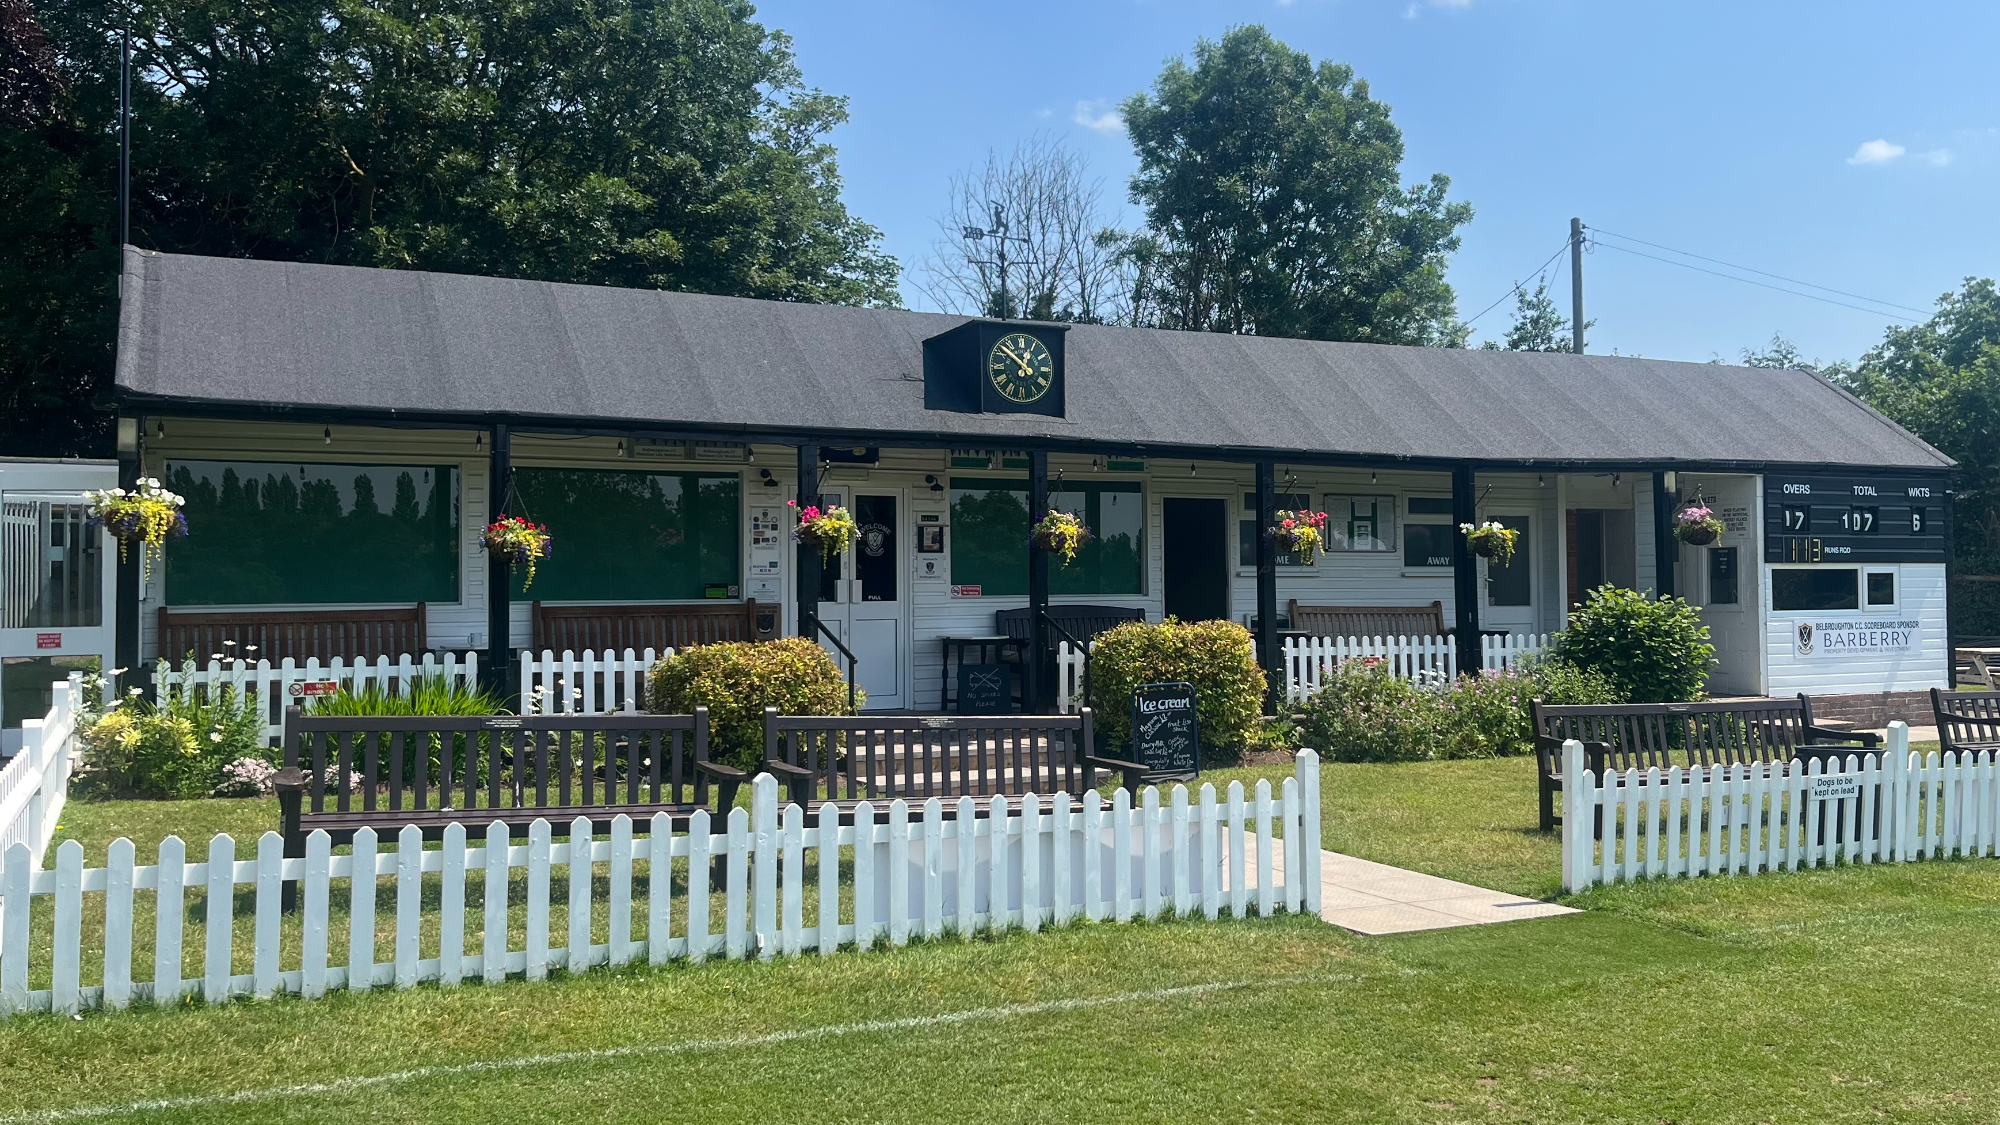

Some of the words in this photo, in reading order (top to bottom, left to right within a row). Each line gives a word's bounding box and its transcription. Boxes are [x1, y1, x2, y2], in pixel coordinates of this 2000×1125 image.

[1784, 484, 1810, 494] OVERS
[1853, 486, 1877, 496] TOTAL
[1908, 488, 1930, 497] WKTS
[1785, 511, 1804, 530] 17
[1842, 514, 1873, 531] 107
[1913, 514, 1920, 531] 6
[860, 523, 892, 535] WELCOME
[1792, 539, 1820, 561] 113
[1427, 556, 1450, 565] AWAY
[1816, 622, 1854, 631] BELBROUGHTON
[1864, 621, 1896, 630] SCOREBOARD
[1824, 631, 1911, 647] BARBERRY
[1140, 697, 1156, 712] Ice
[1158, 698, 1190, 709] cream
[1818, 779, 1835, 787] Dogs
[1815, 789, 1829, 797] kept
